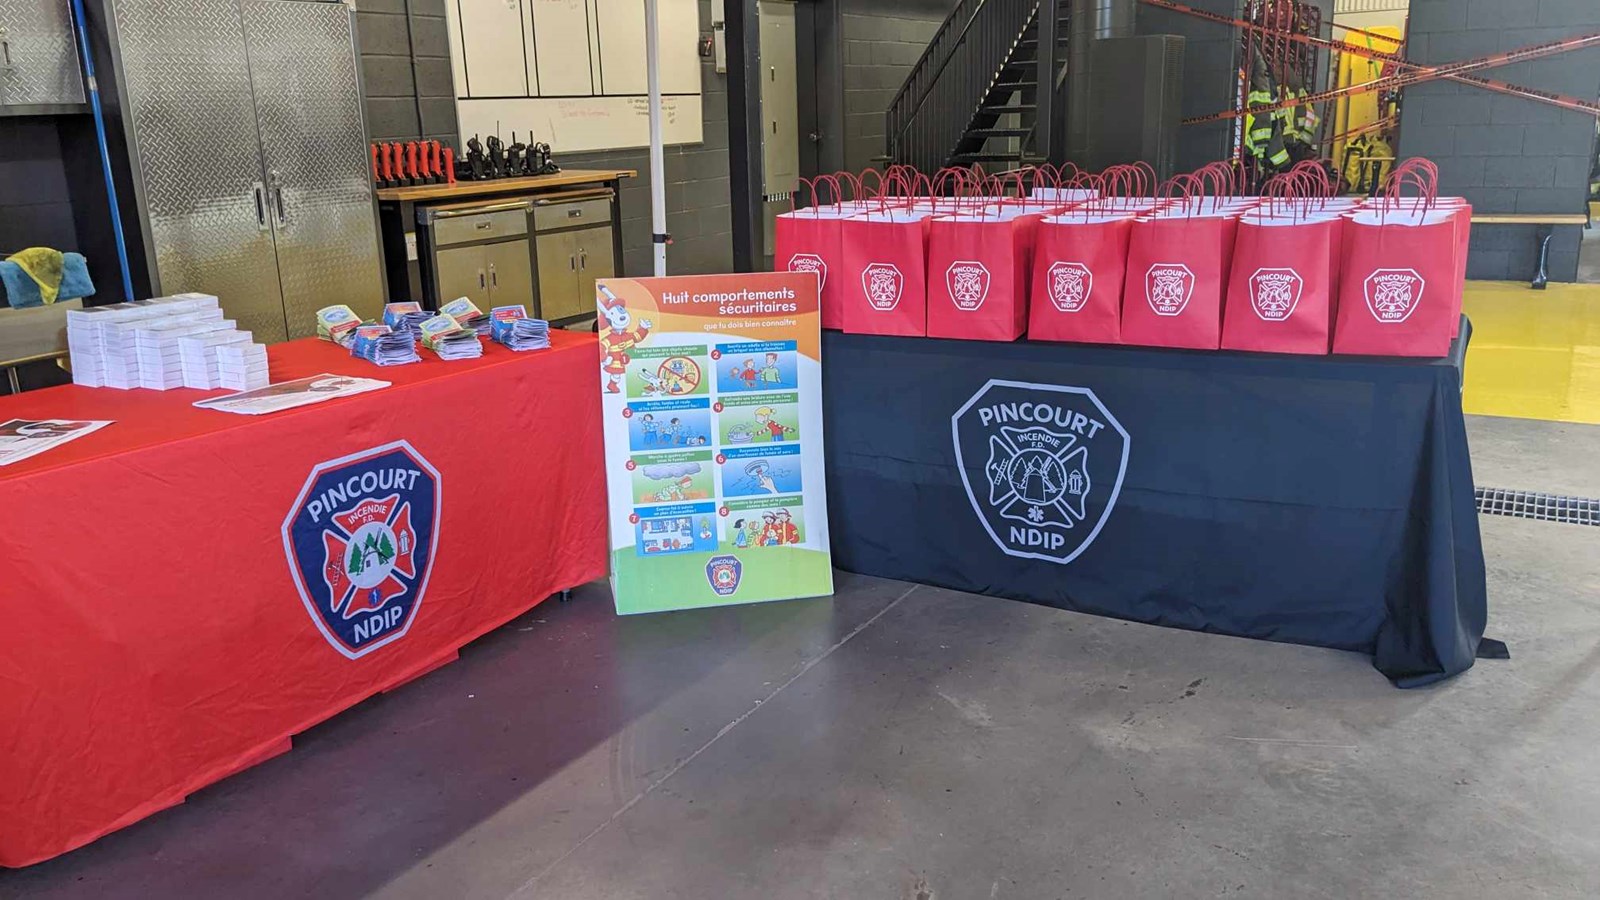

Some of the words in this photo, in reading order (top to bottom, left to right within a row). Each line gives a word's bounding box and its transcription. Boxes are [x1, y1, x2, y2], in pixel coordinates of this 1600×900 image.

[793, 258, 821, 267] PINCOURT
[868, 268, 897, 277] PINCOURT
[952, 266, 983, 276] PINCOURT
[1052, 267, 1087, 277] PINCOURT
[1151, 269, 1188, 279] PINCOURT
[1256, 273, 1296, 283] PINCOURT
[1373, 274, 1417, 284] PINCOURT
[662, 291, 689, 304] Huit
[692, 287, 795, 305] comportements
[719, 300, 797, 315] sécuritaires
[1264, 310, 1284, 318] NDIP
[703, 323, 718, 331] que
[727, 321, 744, 329] dois
[744, 320, 760, 328] bien
[761, 318, 797, 327] connaître
[978, 402, 1105, 439] PINCOURT
[1017, 432, 1061, 448] INCENDIE
[306, 468, 421, 523] PINCOURT
[348, 504, 387, 525] INCENDIE
[362, 514, 375, 524] F.D.
[1010, 526, 1065, 550] NDIP
[352, 605, 403, 643] NDIP
